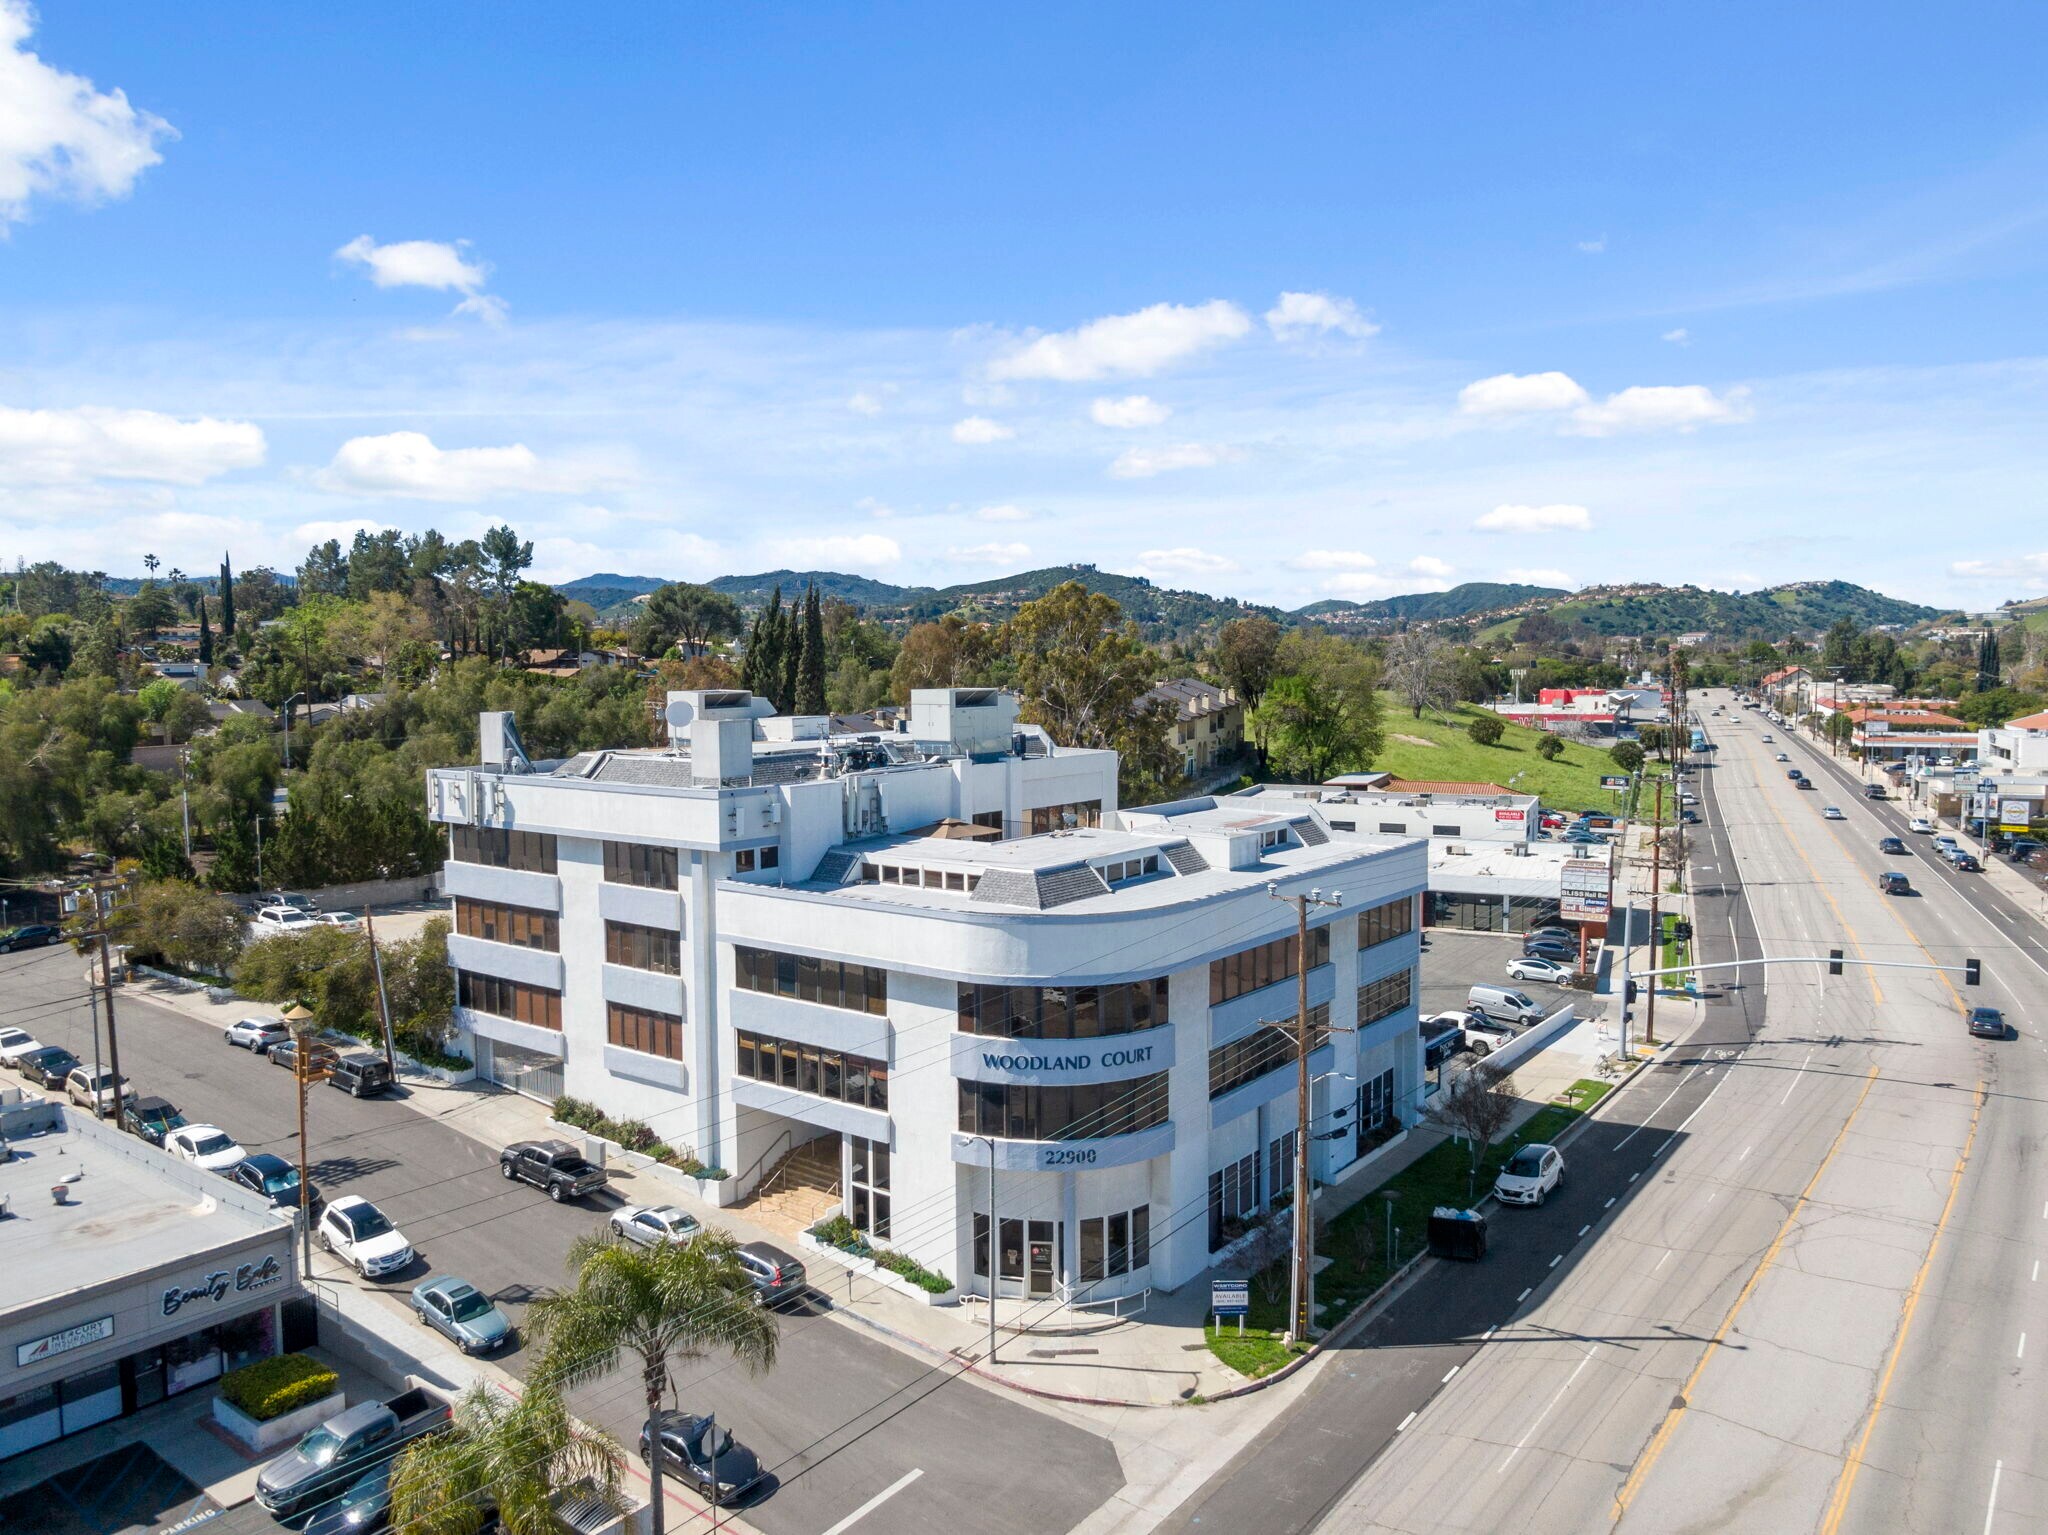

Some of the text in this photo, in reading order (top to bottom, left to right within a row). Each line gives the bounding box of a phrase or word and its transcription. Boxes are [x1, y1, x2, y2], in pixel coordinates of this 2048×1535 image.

[982, 1046, 1153, 1070] WOODLAND COURT
[1045, 1149, 1097, 1165] 22900
[161, 1270, 231, 1317] Beauty
[51, 1320, 104, 1342] MERCURY
[52, 1329, 105, 1349] INSURANCE
[159, 1509, 216, 1535] PARKING
